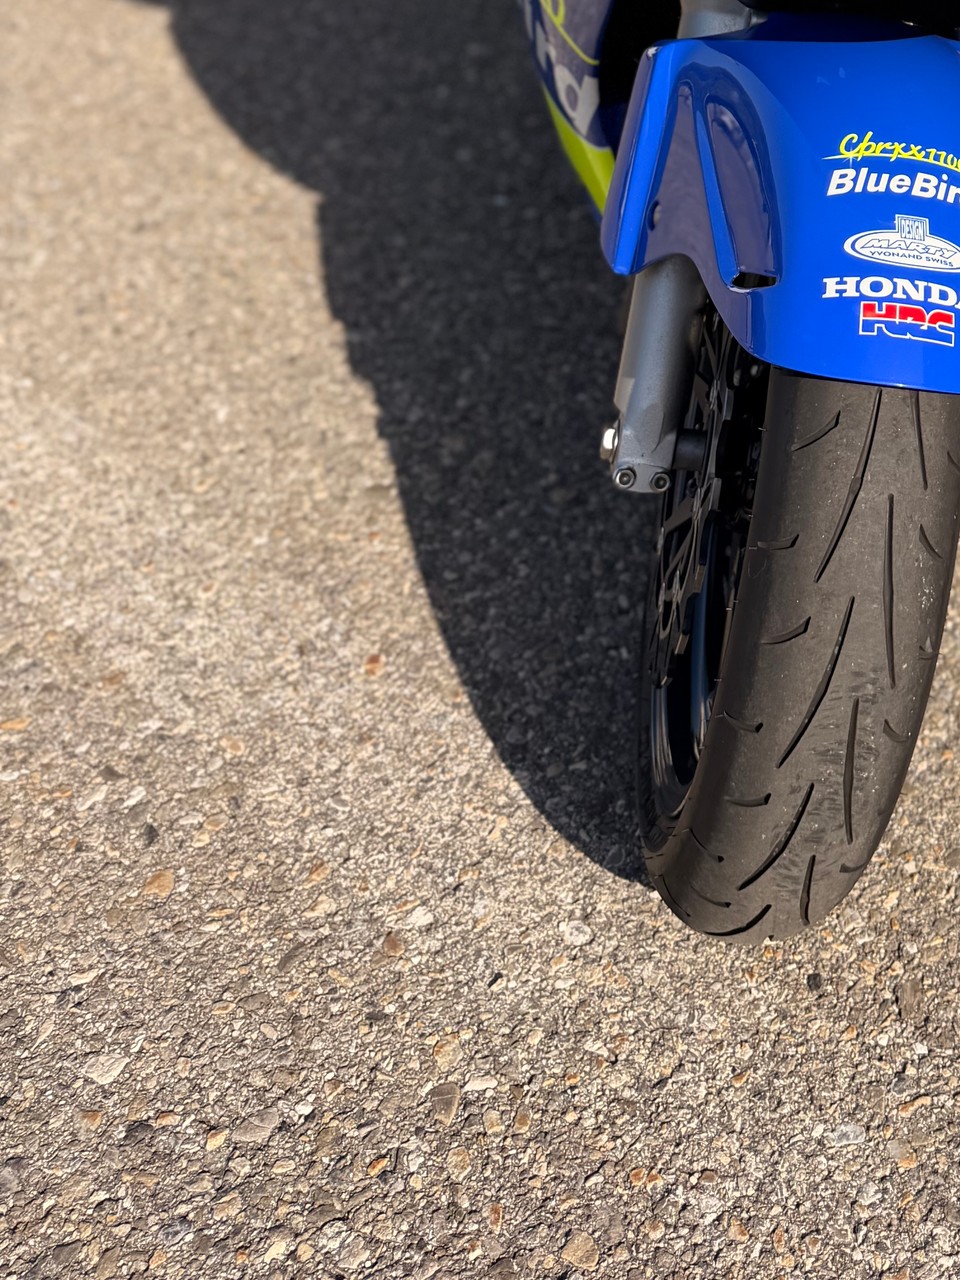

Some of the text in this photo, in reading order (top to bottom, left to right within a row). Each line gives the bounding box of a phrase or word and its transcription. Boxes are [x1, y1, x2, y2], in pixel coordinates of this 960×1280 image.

[861, 238, 957, 260] MARTY
[869, 250, 954, 267] YVONAND SWISS
[859, 301, 954, 347] HRC
